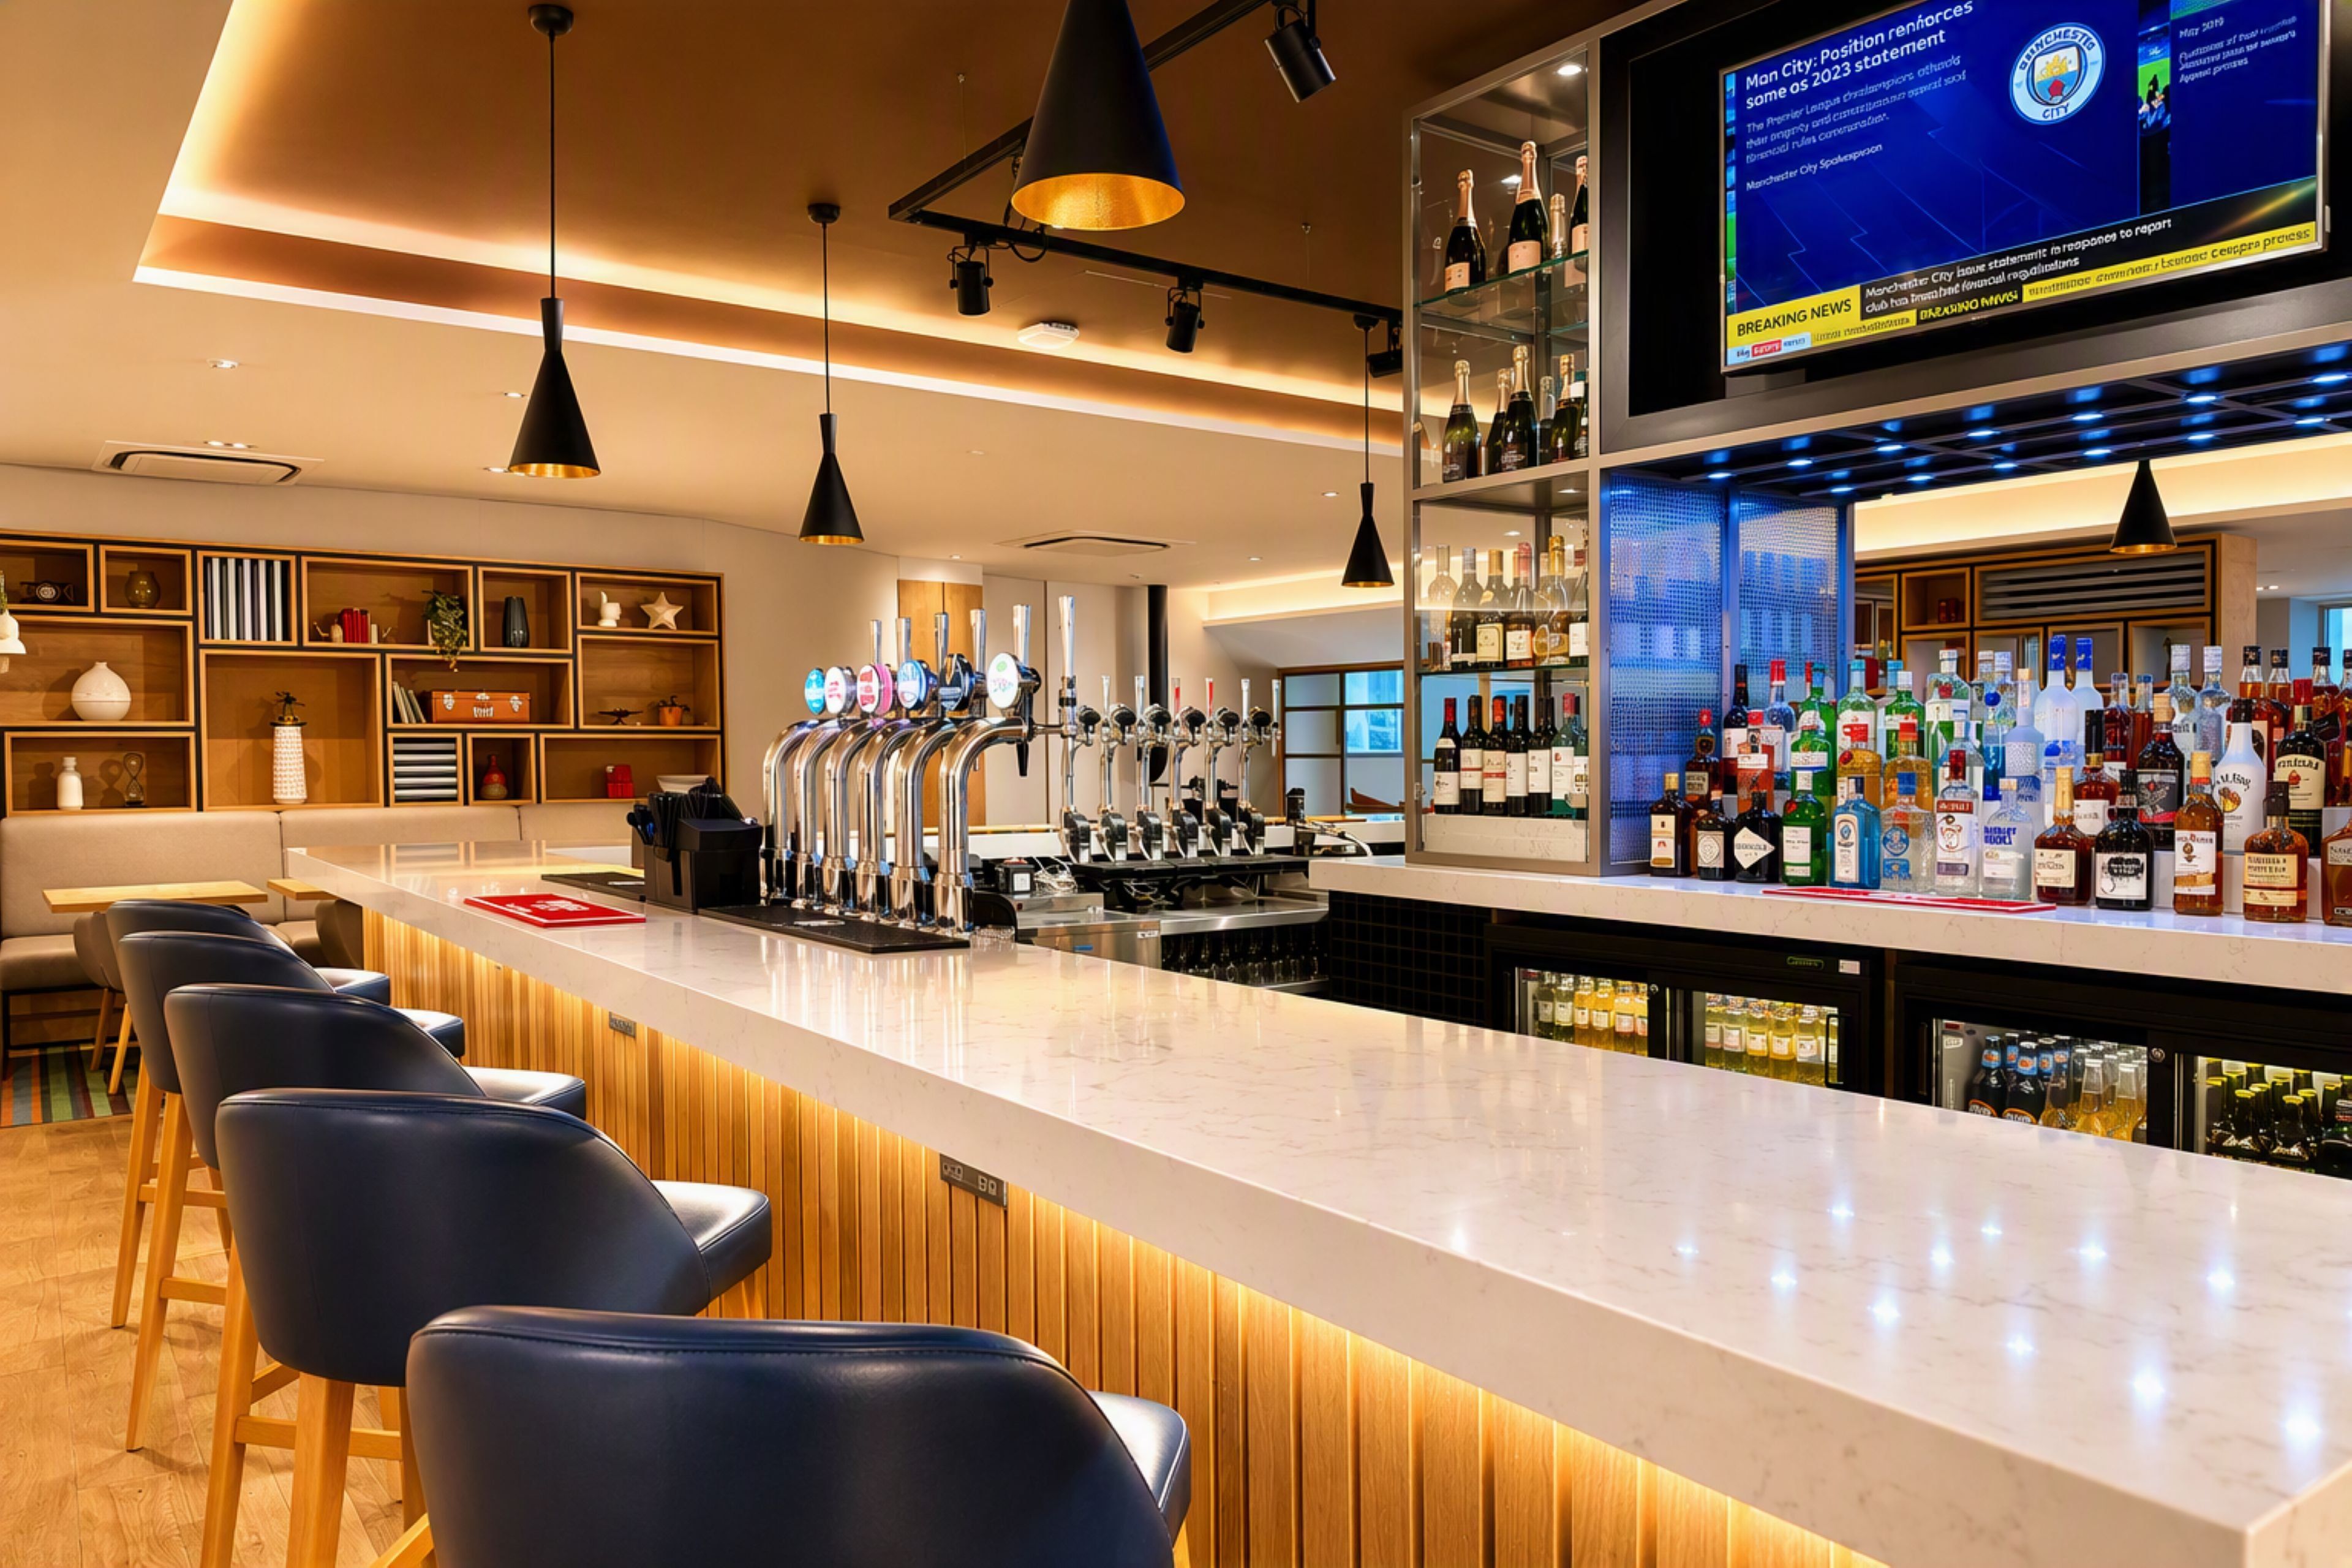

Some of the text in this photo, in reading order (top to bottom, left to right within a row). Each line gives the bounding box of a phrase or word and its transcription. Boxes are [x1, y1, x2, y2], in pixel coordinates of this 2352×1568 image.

[1746, 70, 1777, 90] Man
[1782, 57, 1817, 77] City:
[1821, 32, 1885, 65] Position
[1812, 62, 1851, 87] 2023
[1855, 29, 1946, 72] statement
[2042, 102, 2068, 119] CITY
[2119, 229, 2133, 239] to
[1737, 307, 1807, 337] BREAKING
[1810, 299, 1852, 320] NEWS
